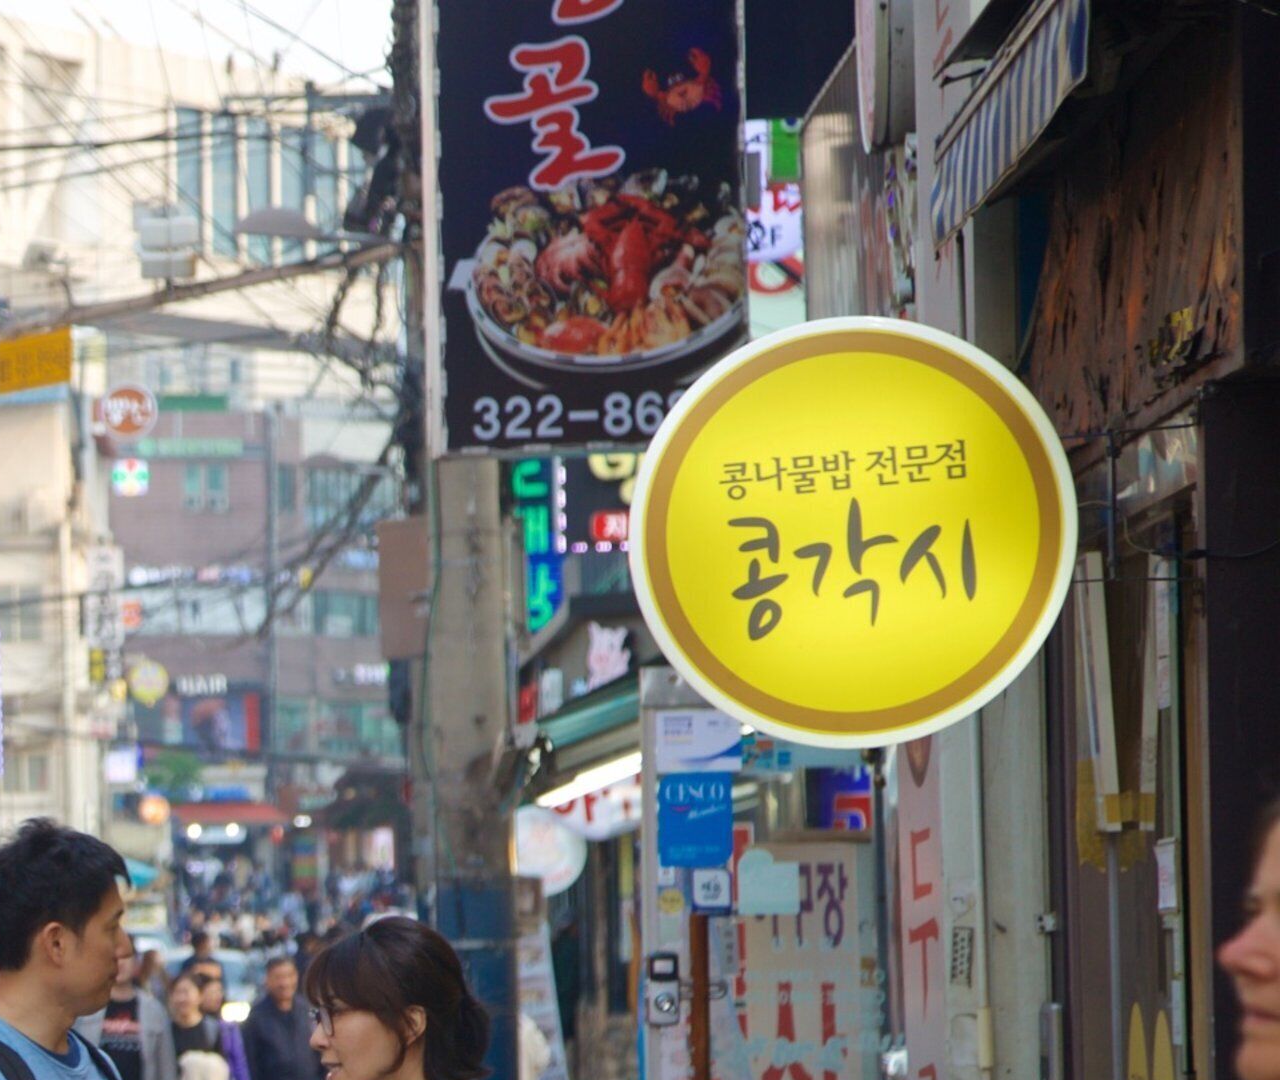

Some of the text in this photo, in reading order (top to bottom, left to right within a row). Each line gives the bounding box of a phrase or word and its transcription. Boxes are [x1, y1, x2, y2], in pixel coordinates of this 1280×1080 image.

[472, 388, 685, 442] 322-86
[719, 439, 968, 501] 콩나물밥 전문점
[727, 496, 978, 642] 콩각시
[665, 782, 725, 801] CESCO
